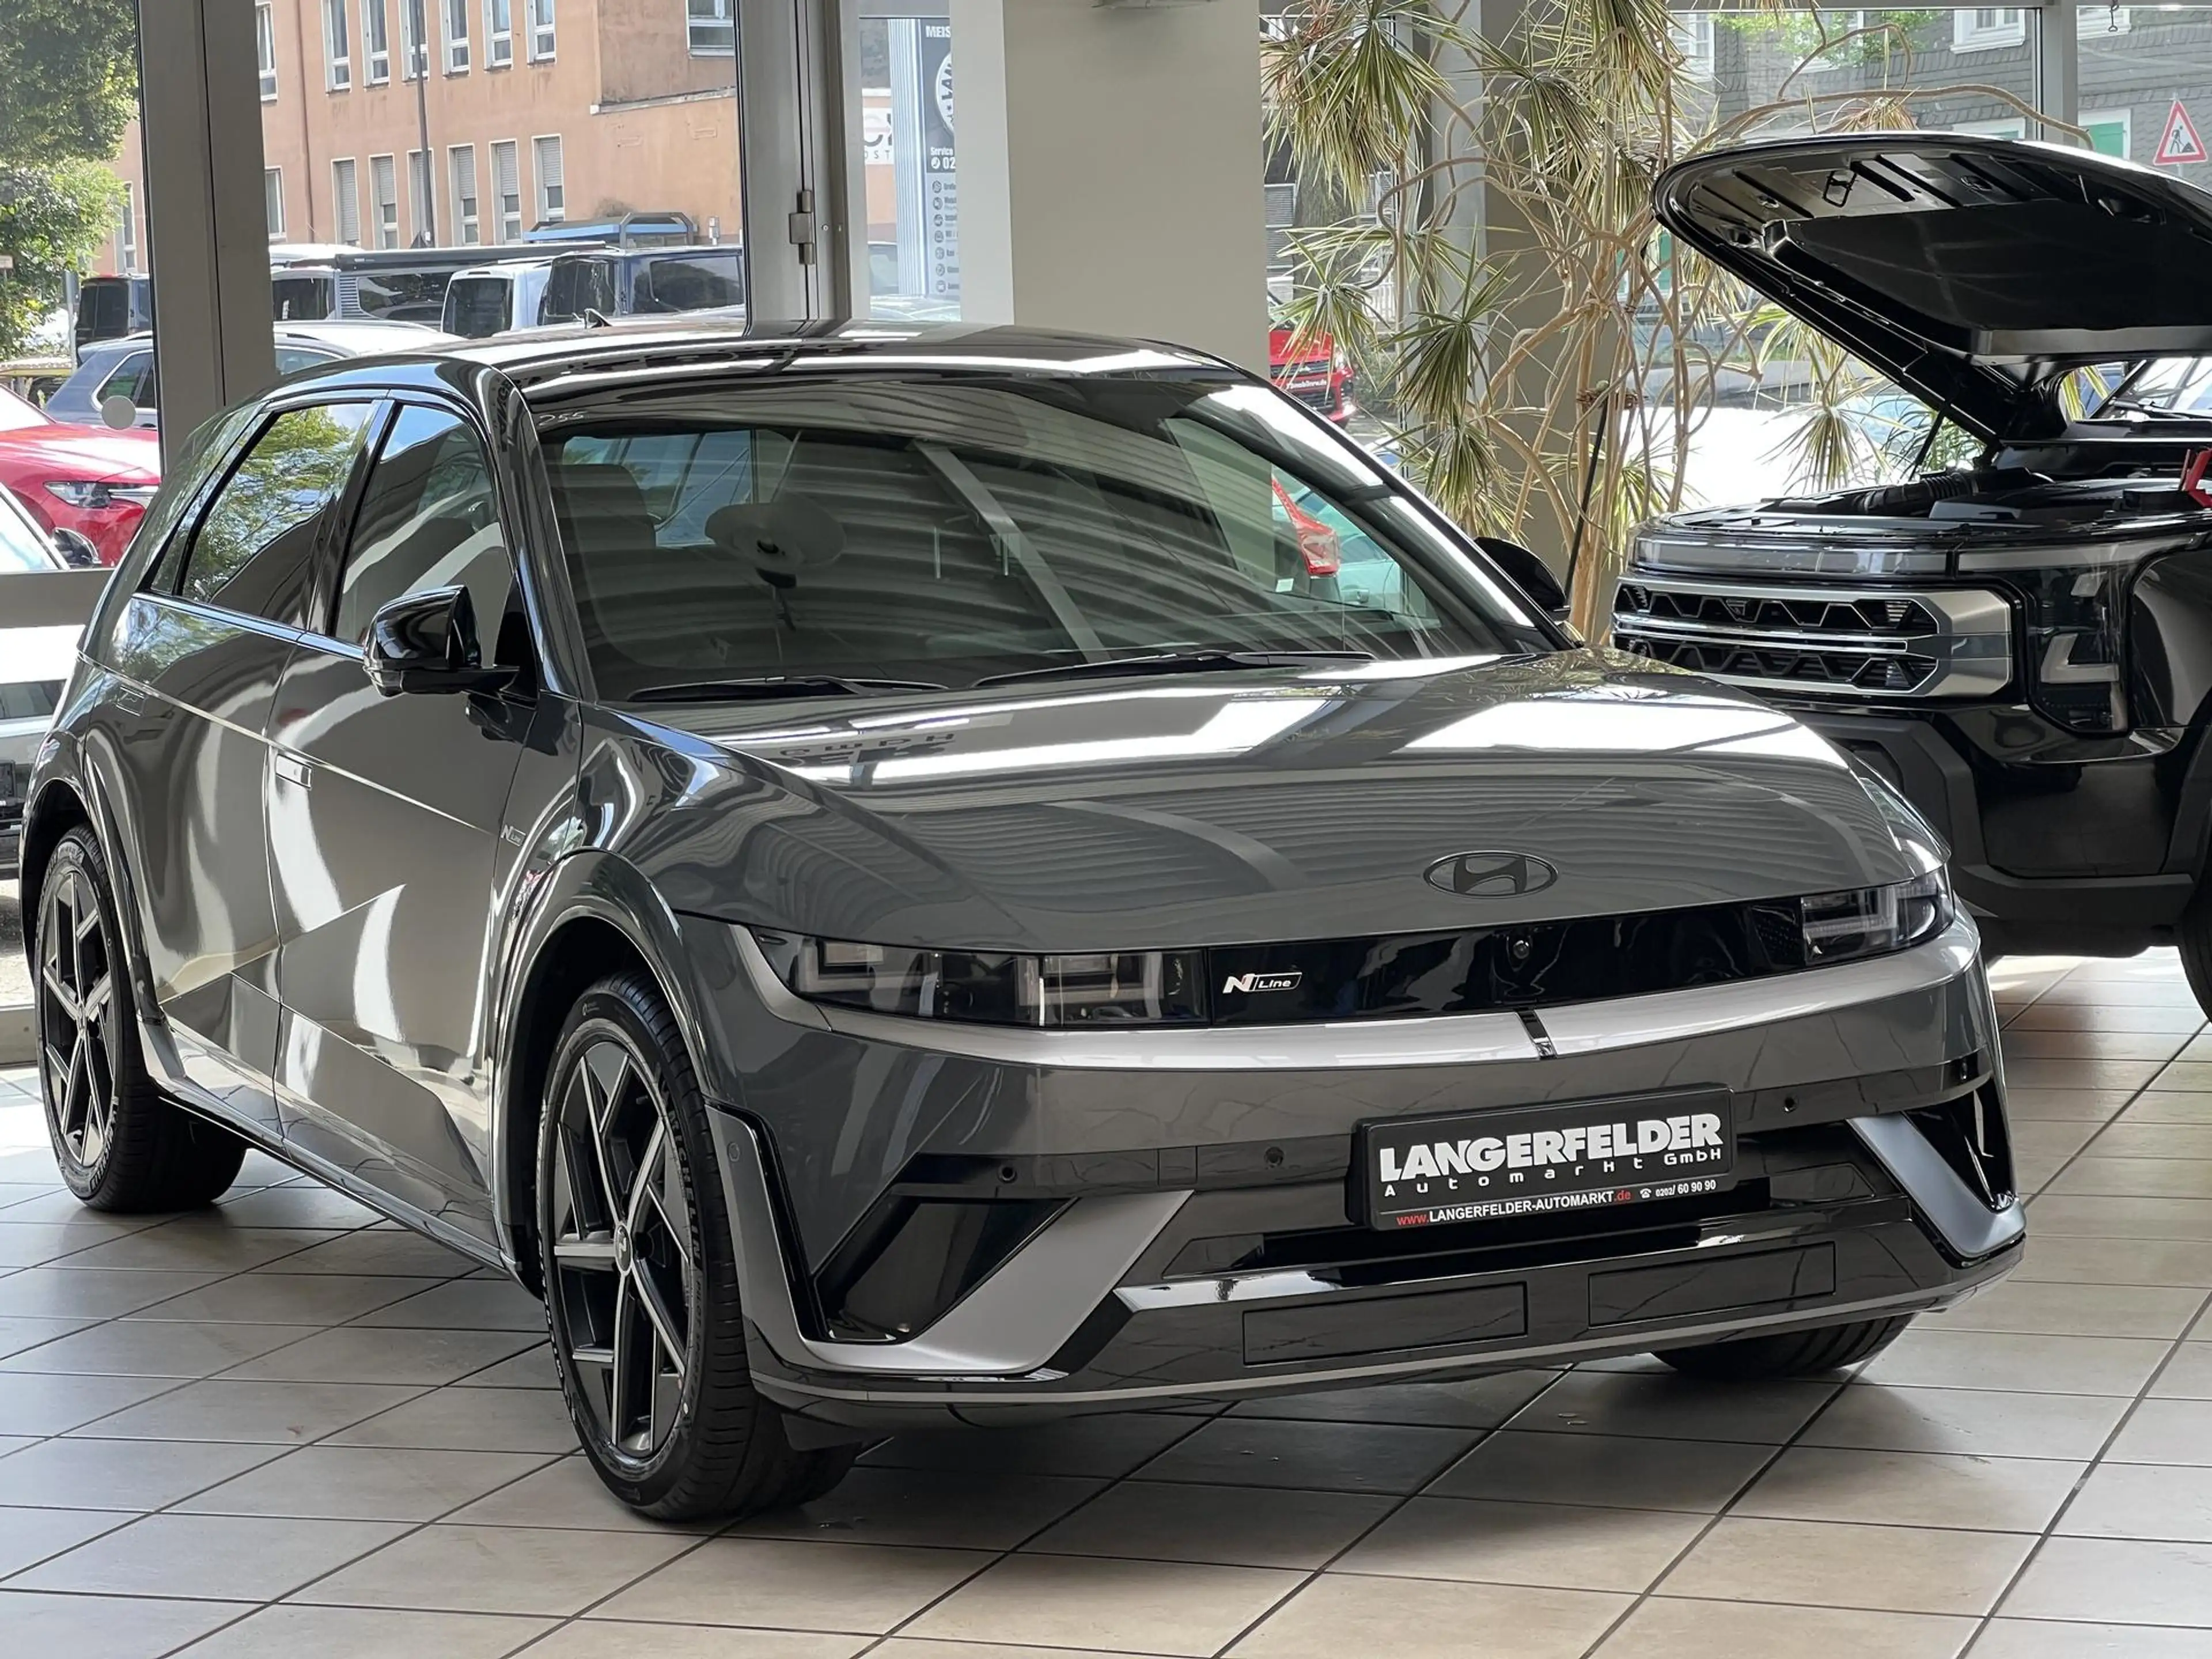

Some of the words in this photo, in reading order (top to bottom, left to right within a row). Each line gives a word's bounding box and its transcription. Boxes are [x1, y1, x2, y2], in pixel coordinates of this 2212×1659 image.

[1222, 973, 1256, 994] N
[1257, 979, 1292, 988] Line
[1380, 1113, 1723, 1183] LANGERFELDER
[1664, 1147, 1722, 1166] GmbH
[1396, 1189, 1632, 1226] www.LANGERFELDER-AUTOMARKT.de
[1677, 1183, 1690, 1195] 60
[1691, 1181, 1703, 1193] 90
[1705, 1180, 1717, 1191] 90
